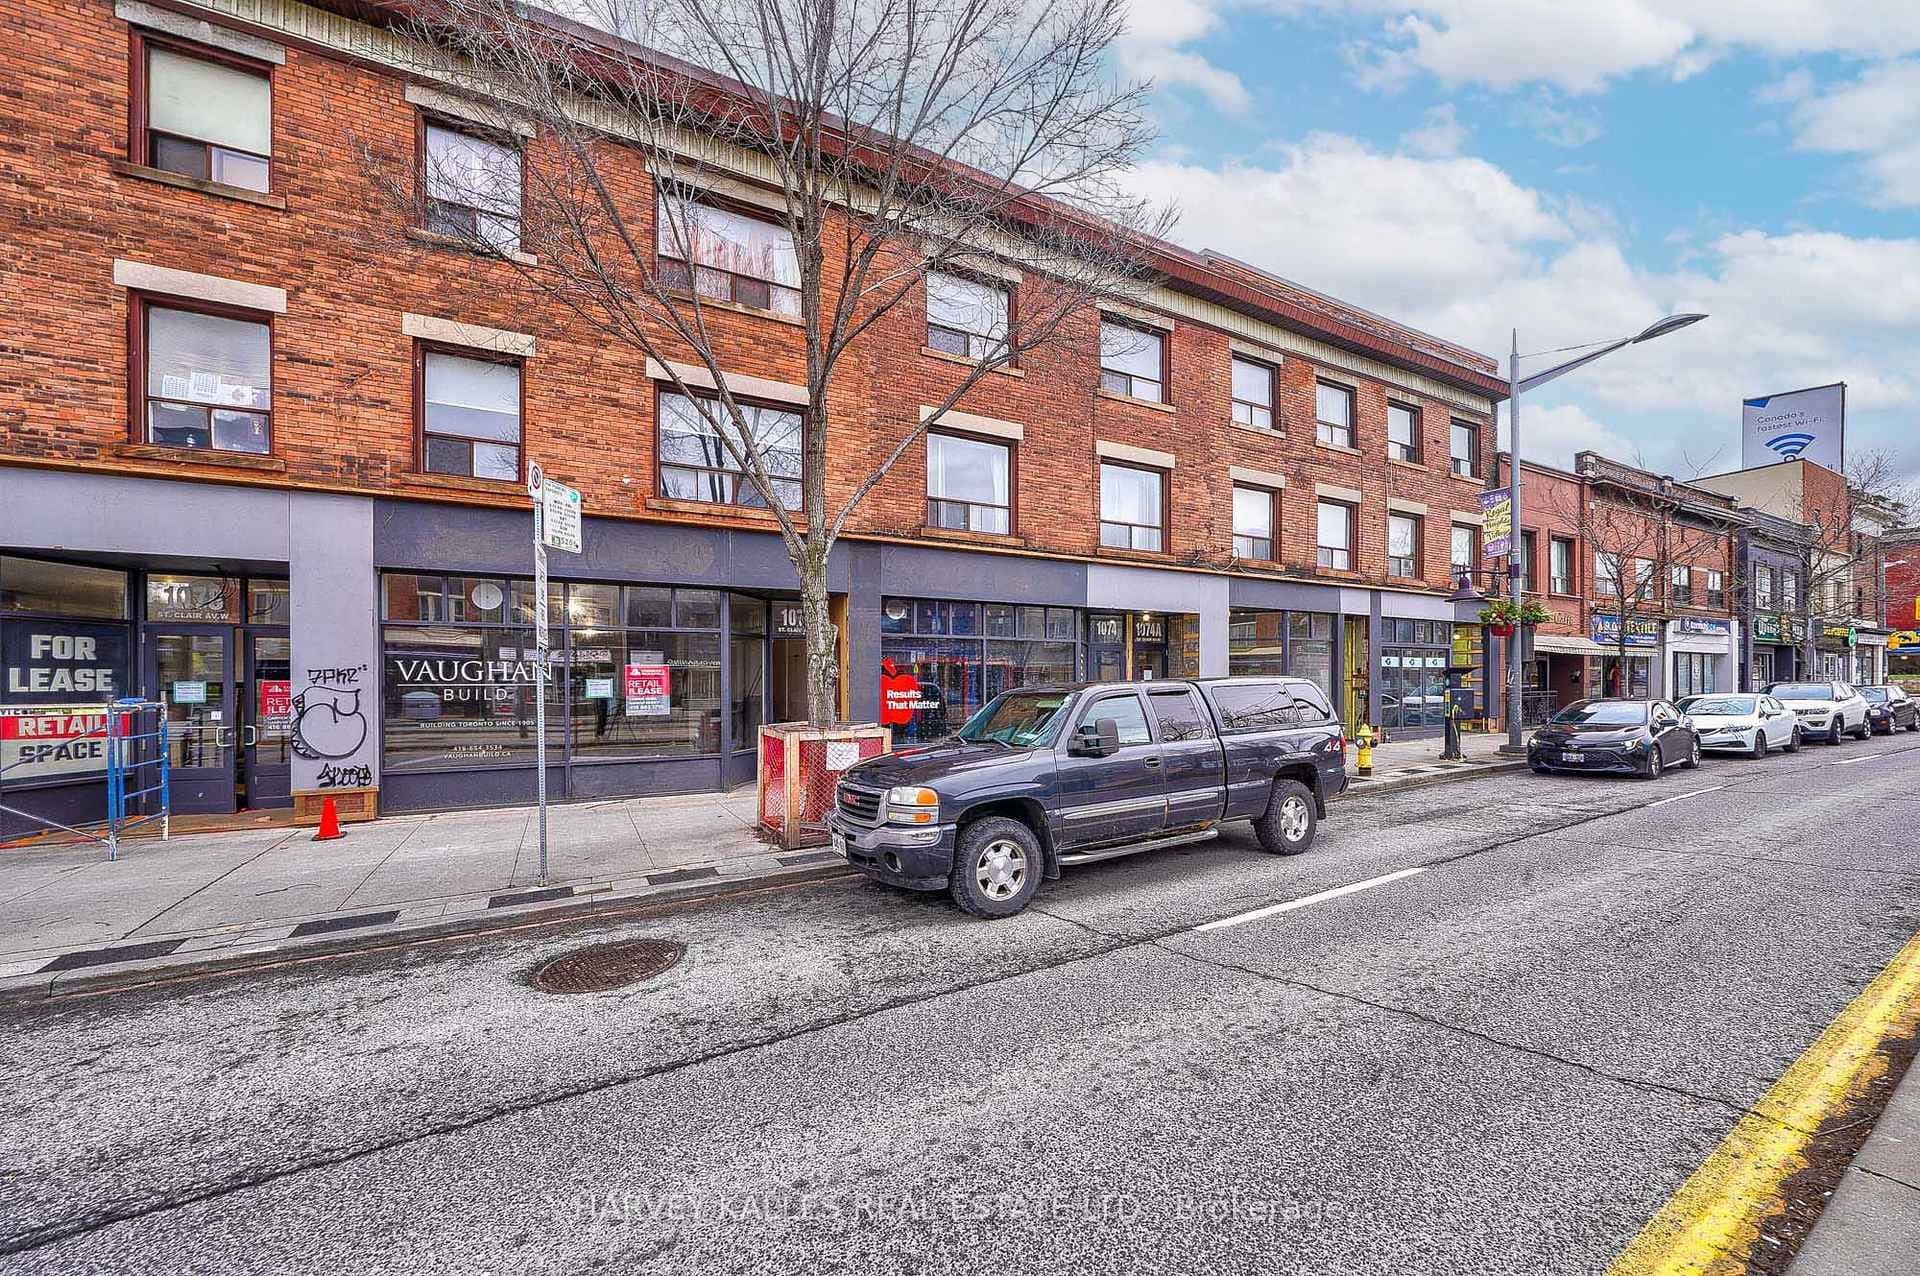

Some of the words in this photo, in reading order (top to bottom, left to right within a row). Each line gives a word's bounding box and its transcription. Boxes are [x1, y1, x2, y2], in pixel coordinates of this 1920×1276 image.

[1757, 411, 1805, 424] Canada's
[1757, 422, 1792, 433] fastest
[781, 608, 803, 627] 107
[1096, 620, 1117, 636] 1074
[1136, 622, 1161, 637] 1074A
[30, 634, 97, 660] FOR
[395, 660, 553, 682] VAUGHAN
[9, 667, 113, 692] LEASE
[628, 680, 659, 688] RETAIL
[443, 688, 508, 701] BUILD
[632, 687, 663, 695] LEASE
[886, 689, 922, 699] Results
[267, 697, 291, 705] RET
[887, 701, 908, 710] That
[909, 701, 940, 710] Matter
[18, 714, 108, 737] RETAIL
[419, 721, 456, 729] BUILDING
[19, 741, 103, 763] SPACE
